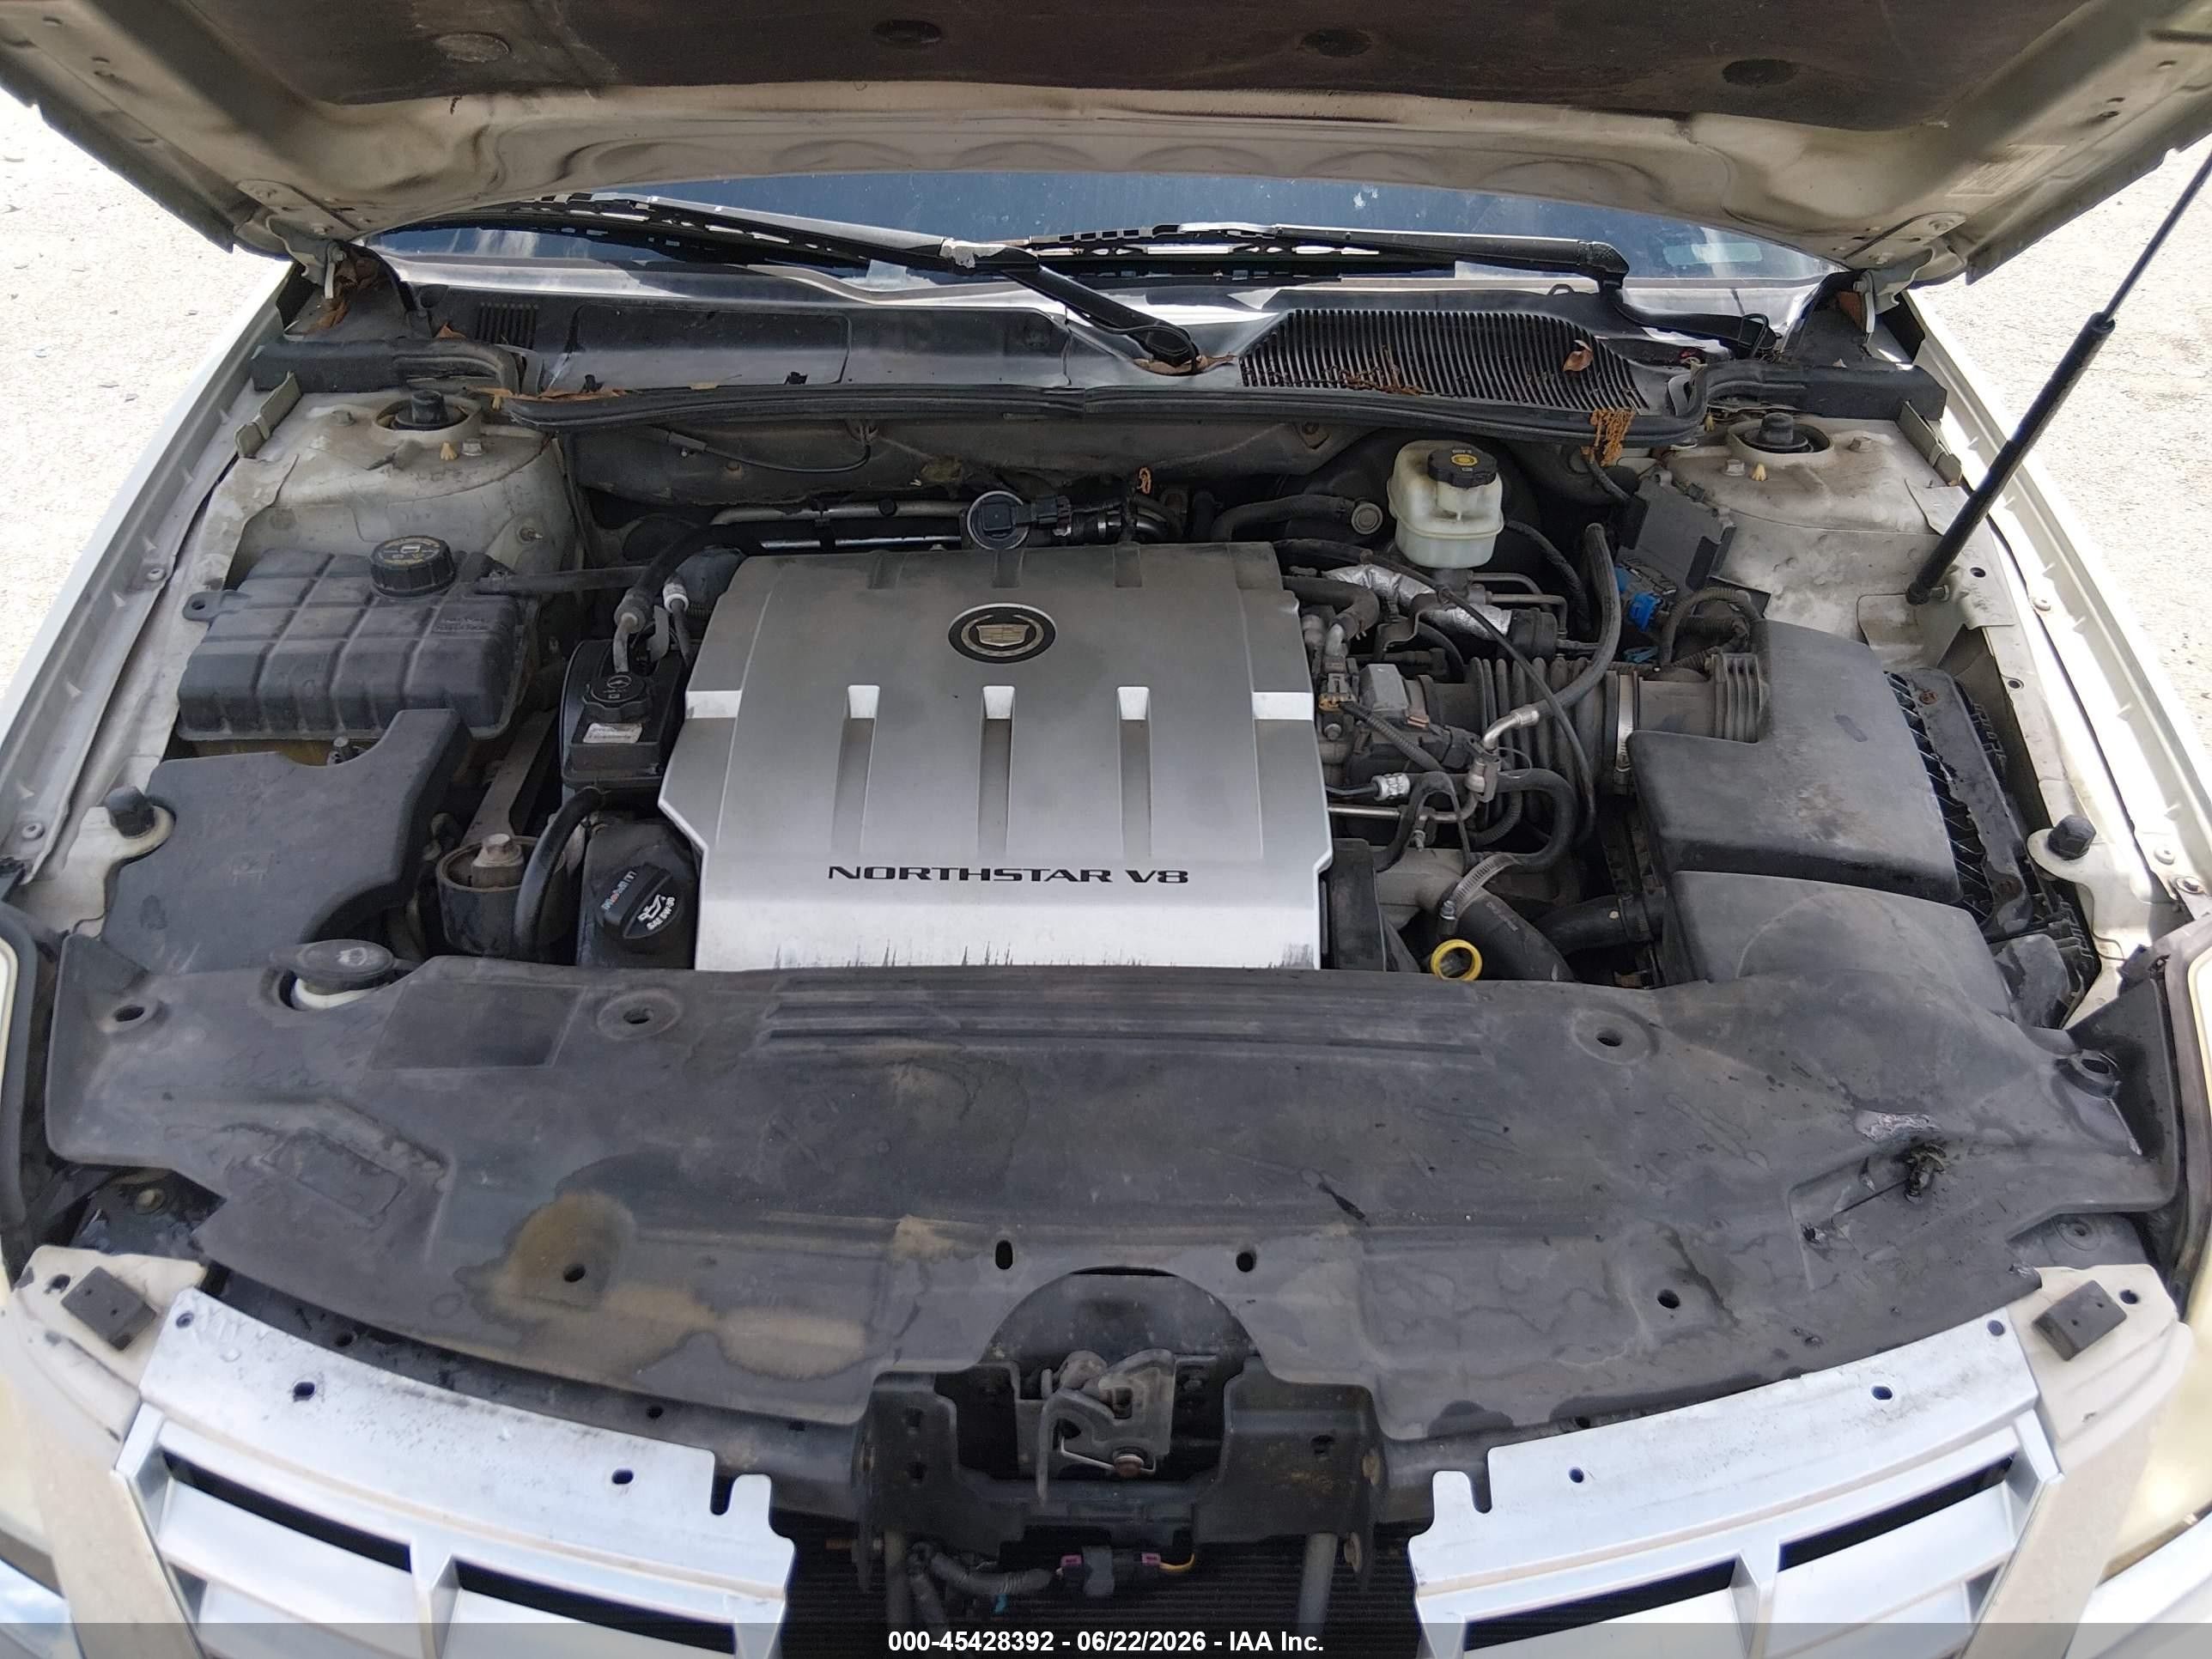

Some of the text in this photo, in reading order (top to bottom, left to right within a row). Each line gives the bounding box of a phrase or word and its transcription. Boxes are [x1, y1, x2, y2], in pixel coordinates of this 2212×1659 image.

[828, 866, 1189, 884] NORTHSTAR V8
[647, 896, 675, 930] SAE 5W-30
